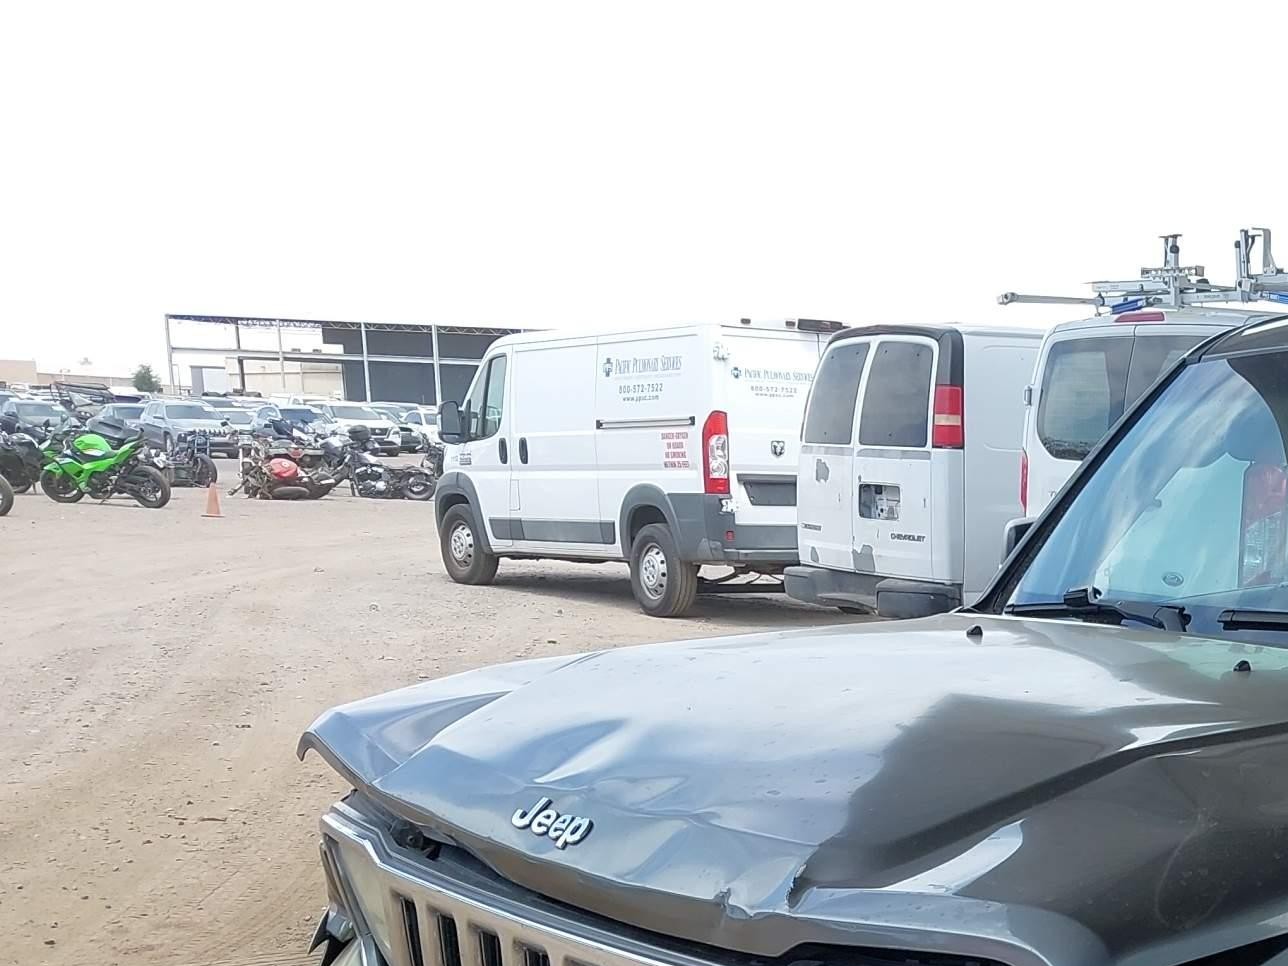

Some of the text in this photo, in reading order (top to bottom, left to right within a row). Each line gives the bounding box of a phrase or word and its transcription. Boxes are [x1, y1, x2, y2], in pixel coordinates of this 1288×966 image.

[632, 357, 659, 374] PULMONARY
[660, 355, 682, 372] SERVICES
[618, 383, 664, 394] 800-572-7522
[890, 533, 926, 543] CHEVROLET
[511, 796, 592, 851] Jeep
